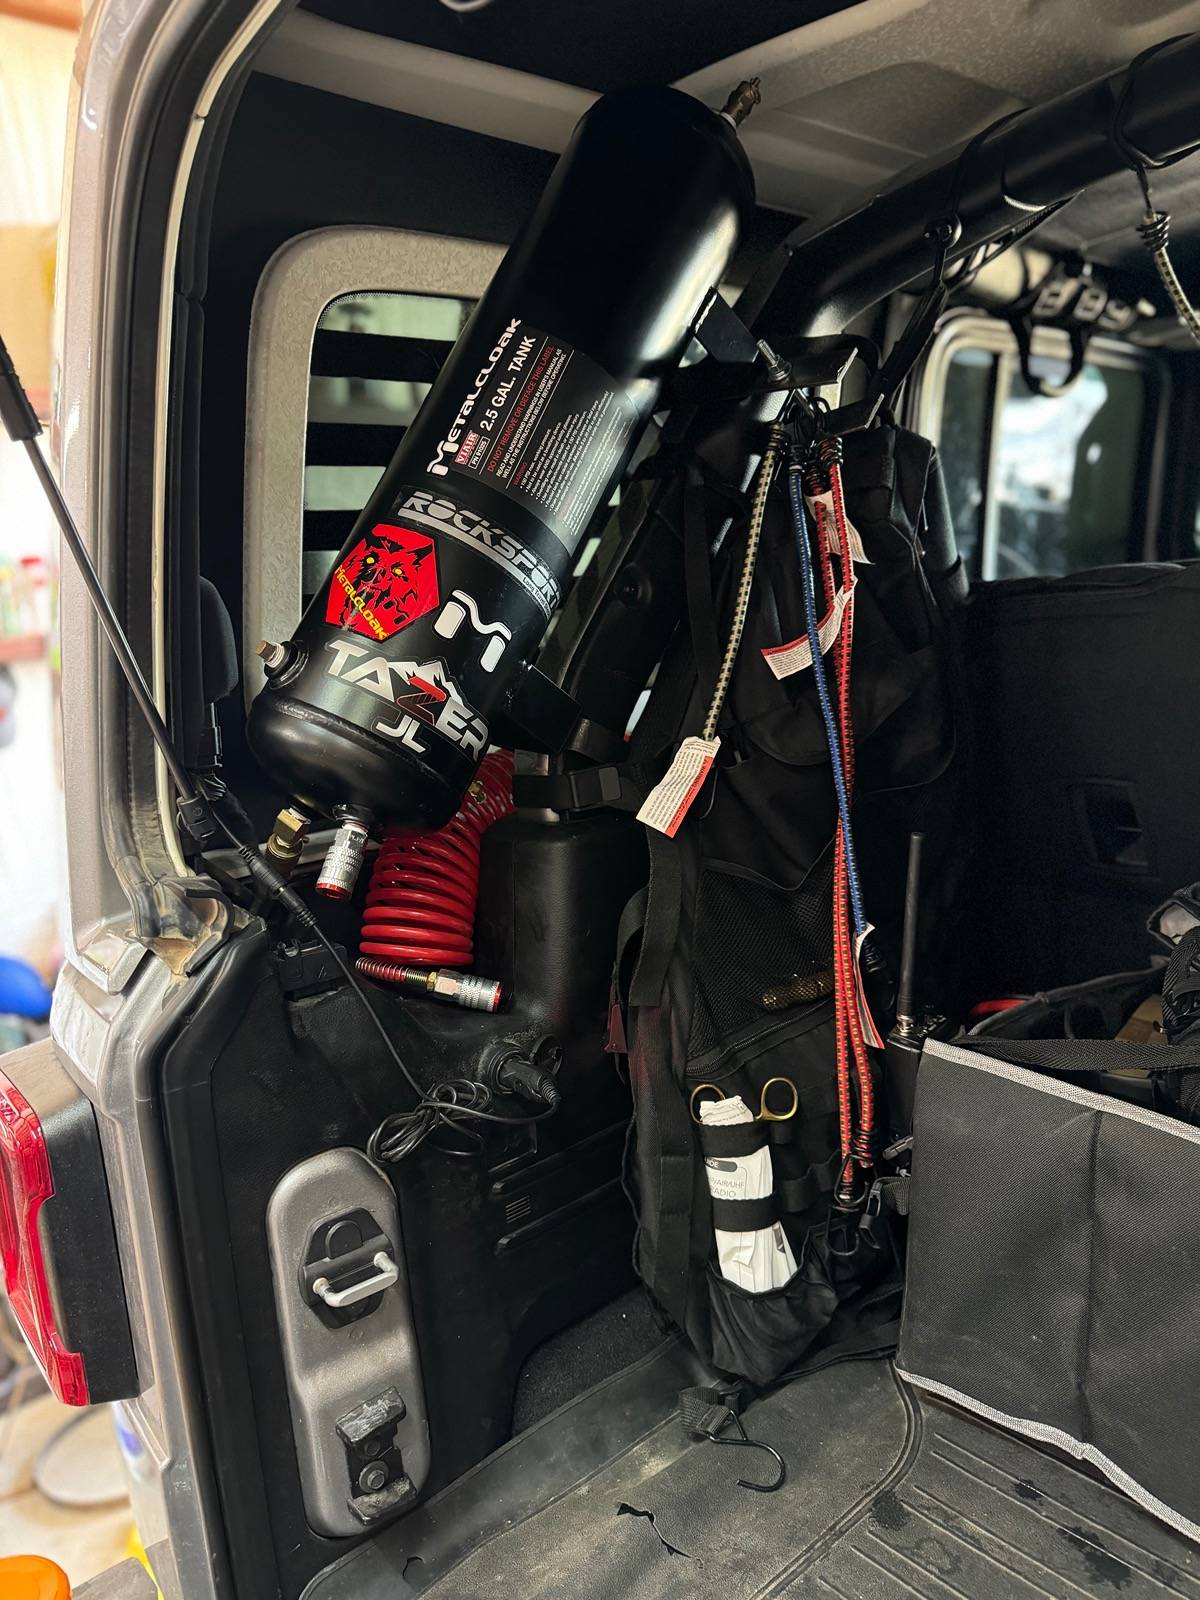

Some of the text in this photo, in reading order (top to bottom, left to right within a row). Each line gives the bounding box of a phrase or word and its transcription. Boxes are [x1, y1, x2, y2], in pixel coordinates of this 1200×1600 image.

[426, 318, 522, 475] METALCLOAK
[478, 332, 536, 432] 2.5 GAL. TANK
[540, 378, 554, 398] BEFORE
[486, 459, 497, 472] DO
[492, 446, 504, 461] NOT
[499, 416, 518, 446] REMOVE
[513, 405, 523, 418] OR
[518, 379, 536, 407] DEFACE
[531, 364, 543, 381] THIS
[495, 461, 506, 477] READ
[502, 451, 511, 463] AND
[507, 420, 526, 453] UNDERSTAND
[522, 396, 538, 422] WARNINGS
[545, 354, 559, 375] MANUAL
[554, 347, 562, 356] AS
[532, 396, 545, 415] BELOW
[456, 431, 477, 464] VIAIR
[516, 413, 537, 448] INSTRUCTIONS
[470, 455, 479, 465] PN
[508, 457, 515, 465] AS
[511, 447, 520, 458] THE
[501, 463, 512, 479] WELL
[402, 491, 560, 608] ROCKSPORT
[327, 640, 489, 762] TAZER
[375, 715, 427, 754] JL
